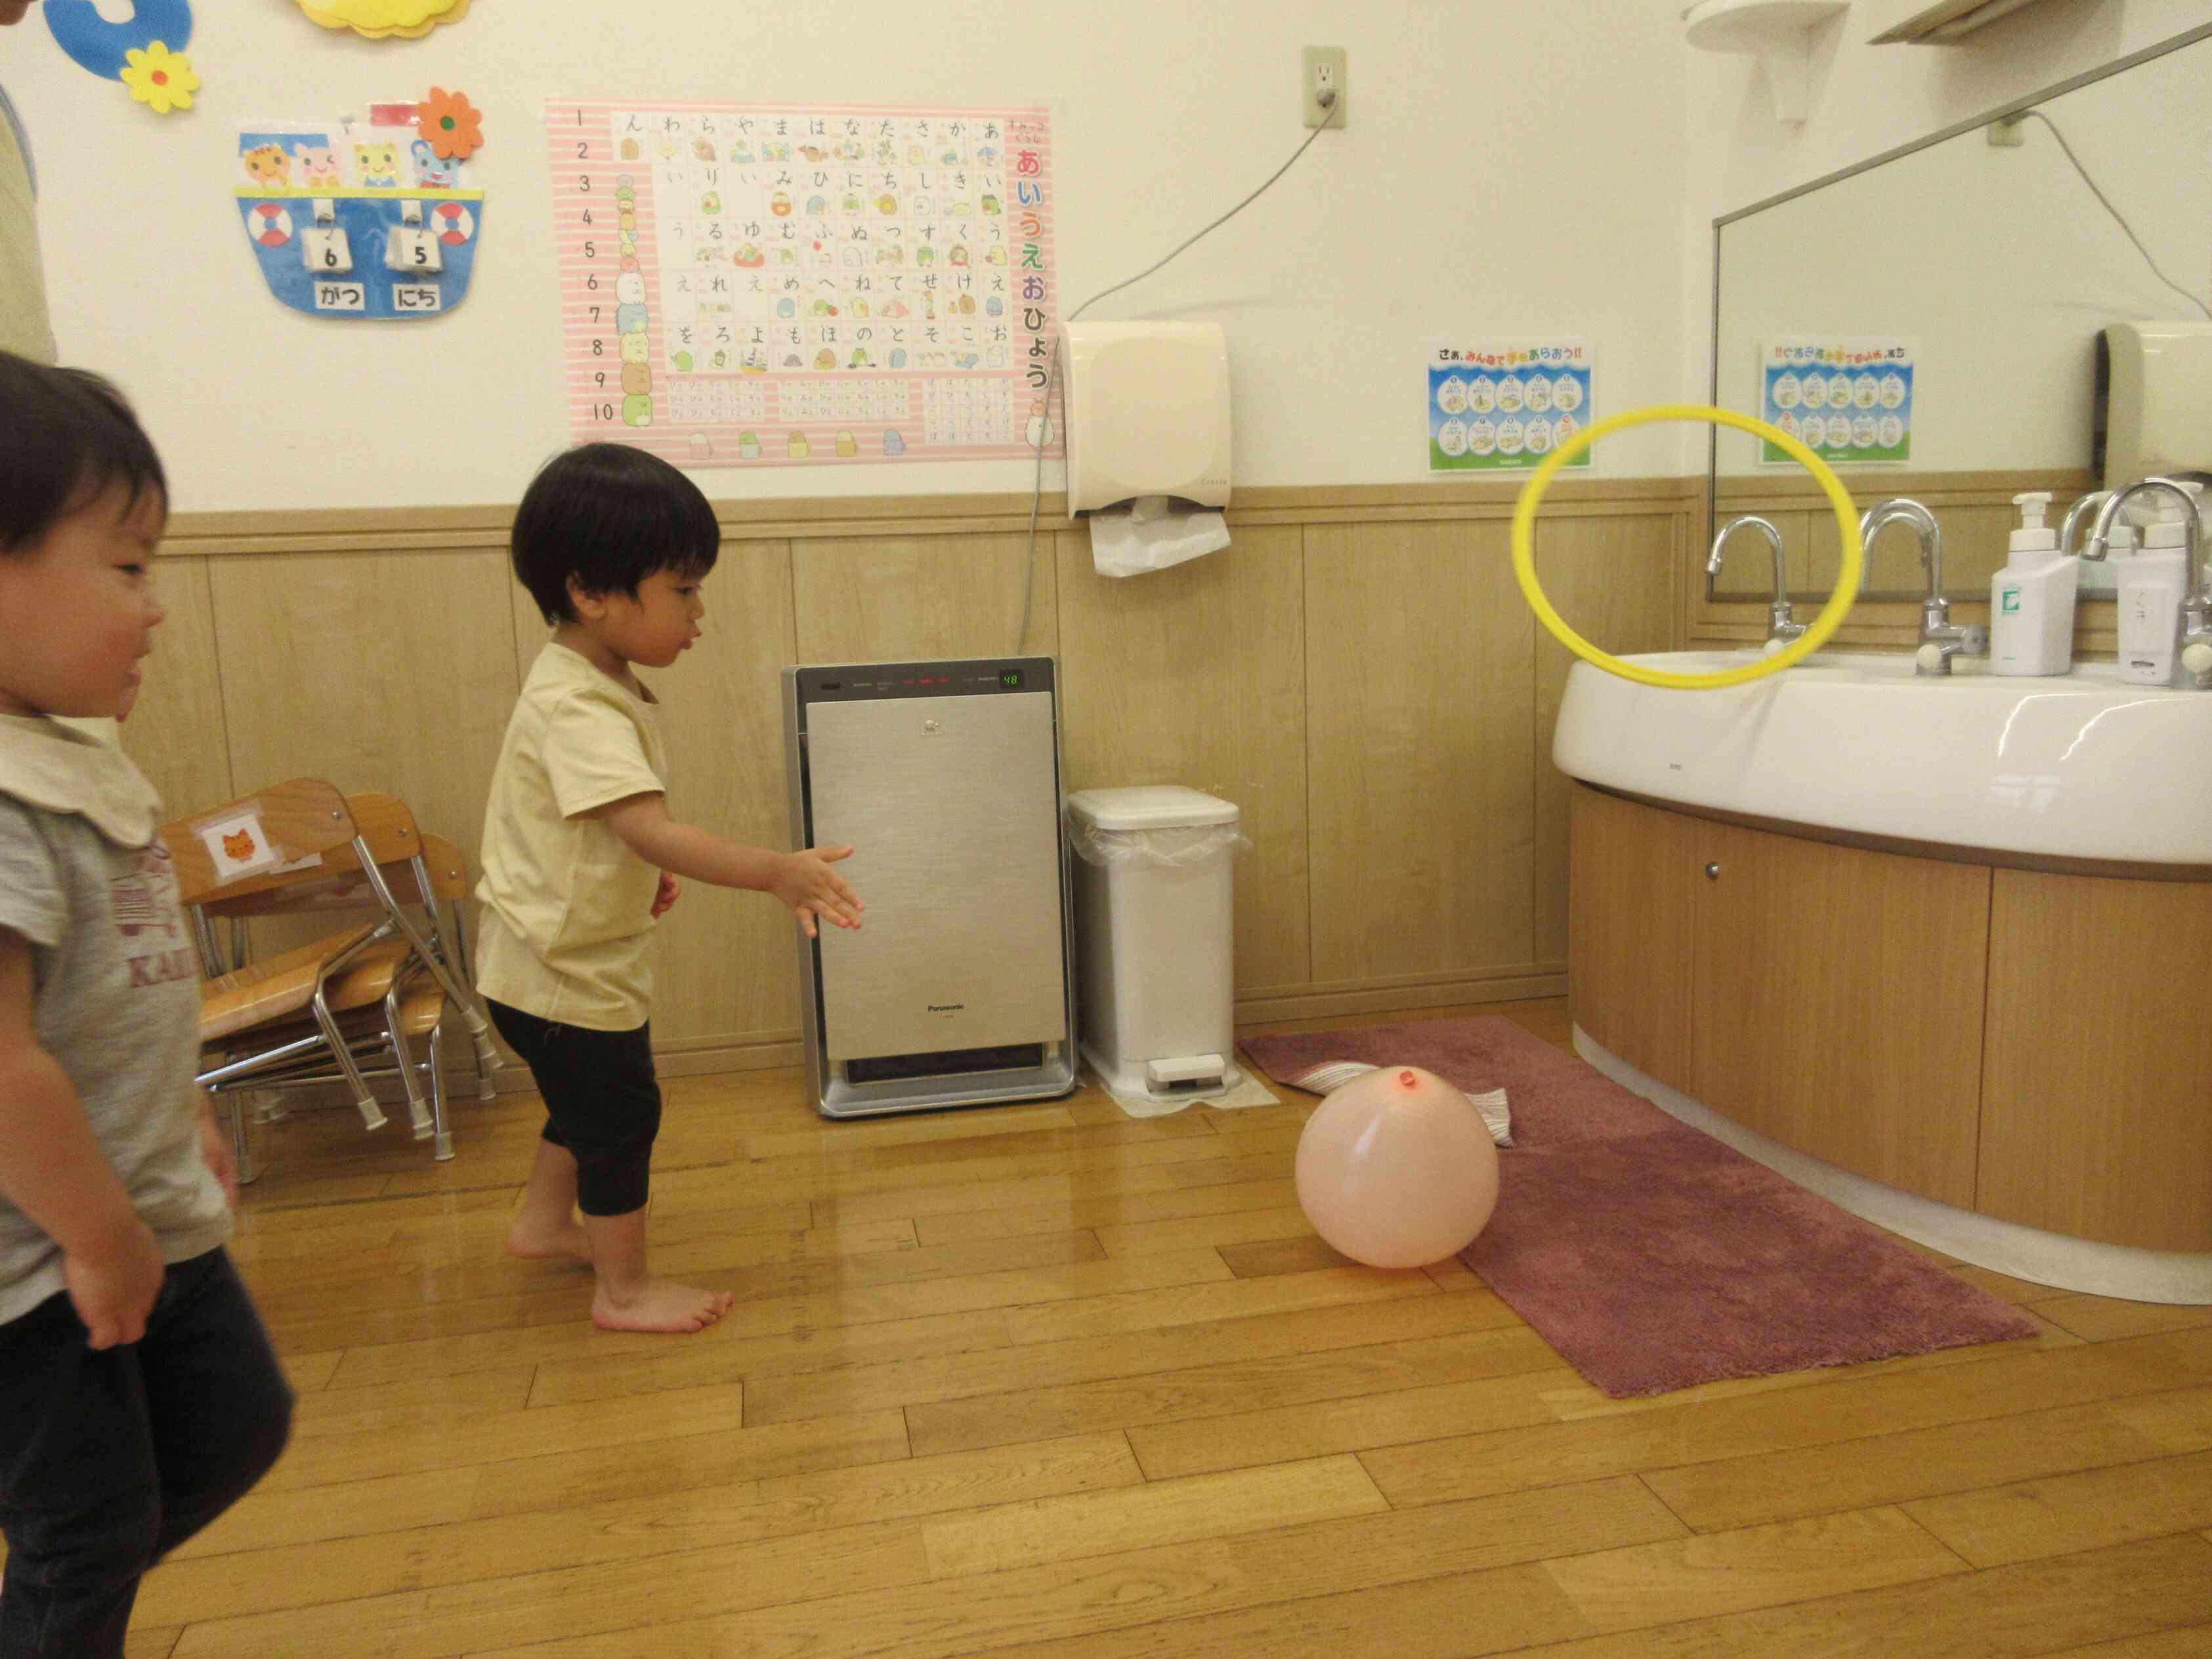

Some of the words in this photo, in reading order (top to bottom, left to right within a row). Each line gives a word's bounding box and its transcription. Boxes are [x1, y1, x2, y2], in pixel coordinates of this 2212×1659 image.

[577, 110, 582, 127] 1
[627, 114, 643, 131] ん
[663, 116, 681, 133] わ
[702, 115, 715, 132] ら
[734, 116, 754, 135] や
[776, 119, 790, 136] ま
[810, 118, 825, 136] は
[845, 118, 861, 136] な
[880, 119, 895, 136] た
[915, 119, 929, 137] さ
[949, 121, 967, 136] か
[983, 121, 999, 138] あ
[577, 142, 589, 159] 2
[579, 175, 591, 192] 3
[667, 172, 683, 183] い
[706, 168, 717, 186] り
[740, 172, 757, 184] い
[776, 170, 793, 185] み
[813, 171, 829, 188] ひ
[848, 172, 864, 188] に
[881, 172, 897, 189] ち
[921, 173, 931, 189] し
[954, 171, 967, 190] き
[984, 173, 1002, 188] い
[582, 208, 593, 225] 4
[673, 222, 683, 238] う
[709, 222, 723, 240] る
[744, 221, 760, 238] ゆ
[781, 222, 796, 239] む
[815, 220, 834, 239] ふ
[851, 225, 868, 241] ぬ
[886, 226, 901, 238] つ
[920, 224, 935, 241] す
[959, 224, 968, 240] く
[989, 221, 1000, 240] う
[324, 247, 338, 267] 6
[414, 245, 428, 264] 5
[584, 242, 595, 258] 5
[1016, 148, 1048, 388] あいうえおひょう
[587, 273, 598, 290] 6
[677, 274, 692, 291] え
[710, 275, 728, 292] れ
[749, 275, 763, 291] え
[784, 276, 800, 290] め
[820, 278, 836, 288] へ
[855, 274, 872, 291] ね
[889, 275, 903, 291] て
[923, 273, 938, 289] せ
[957, 272, 972, 289] け
[992, 274, 1005, 291] え
[321, 287, 361, 306] がつ
[397, 289, 436, 308] にち
[589, 306, 600, 324] 7
[679, 326, 693, 344] を
[715, 326, 730, 343] ろ
[751, 326, 763, 343] よ
[790, 327, 801, 345] も
[821, 326, 837, 343] ほ
[856, 327, 872, 341] の
[891, 326, 904, 342] と
[924, 327, 939, 343] そ
[962, 327, 974, 341] こ
[993, 324, 1008, 342] お
[592, 339, 604, 356] 8
[595, 371, 605, 388] 9
[593, 403, 614, 420] 10
[1002, 674, 1019, 685] 48
